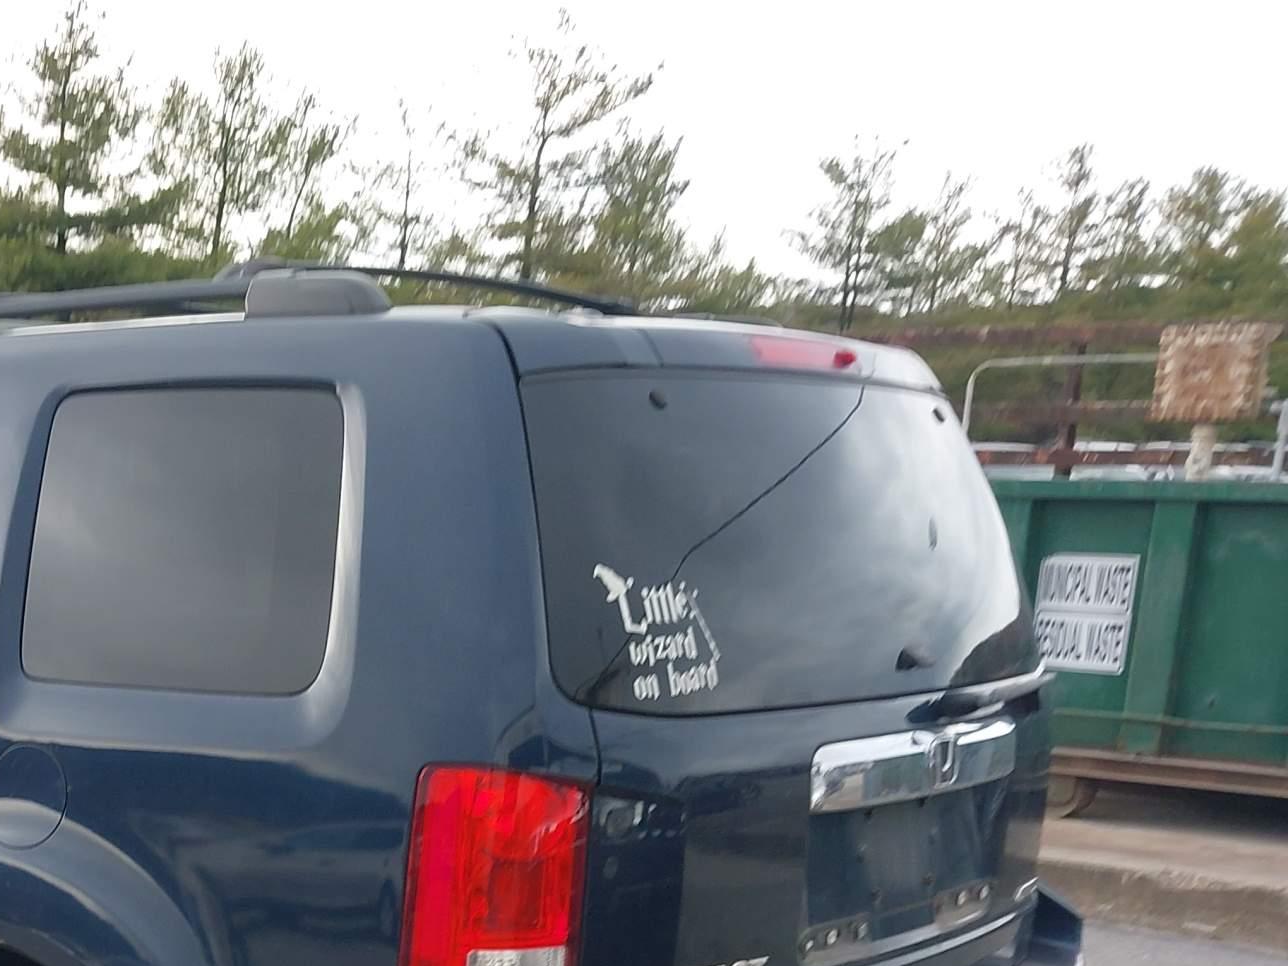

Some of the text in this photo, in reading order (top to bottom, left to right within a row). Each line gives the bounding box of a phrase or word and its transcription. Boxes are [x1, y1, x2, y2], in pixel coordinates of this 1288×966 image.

[1094, 562, 1132, 606] WASTE
[628, 625, 699, 667] wizard
[1085, 621, 1124, 665] WASTE
[632, 658, 720, 701] on board
